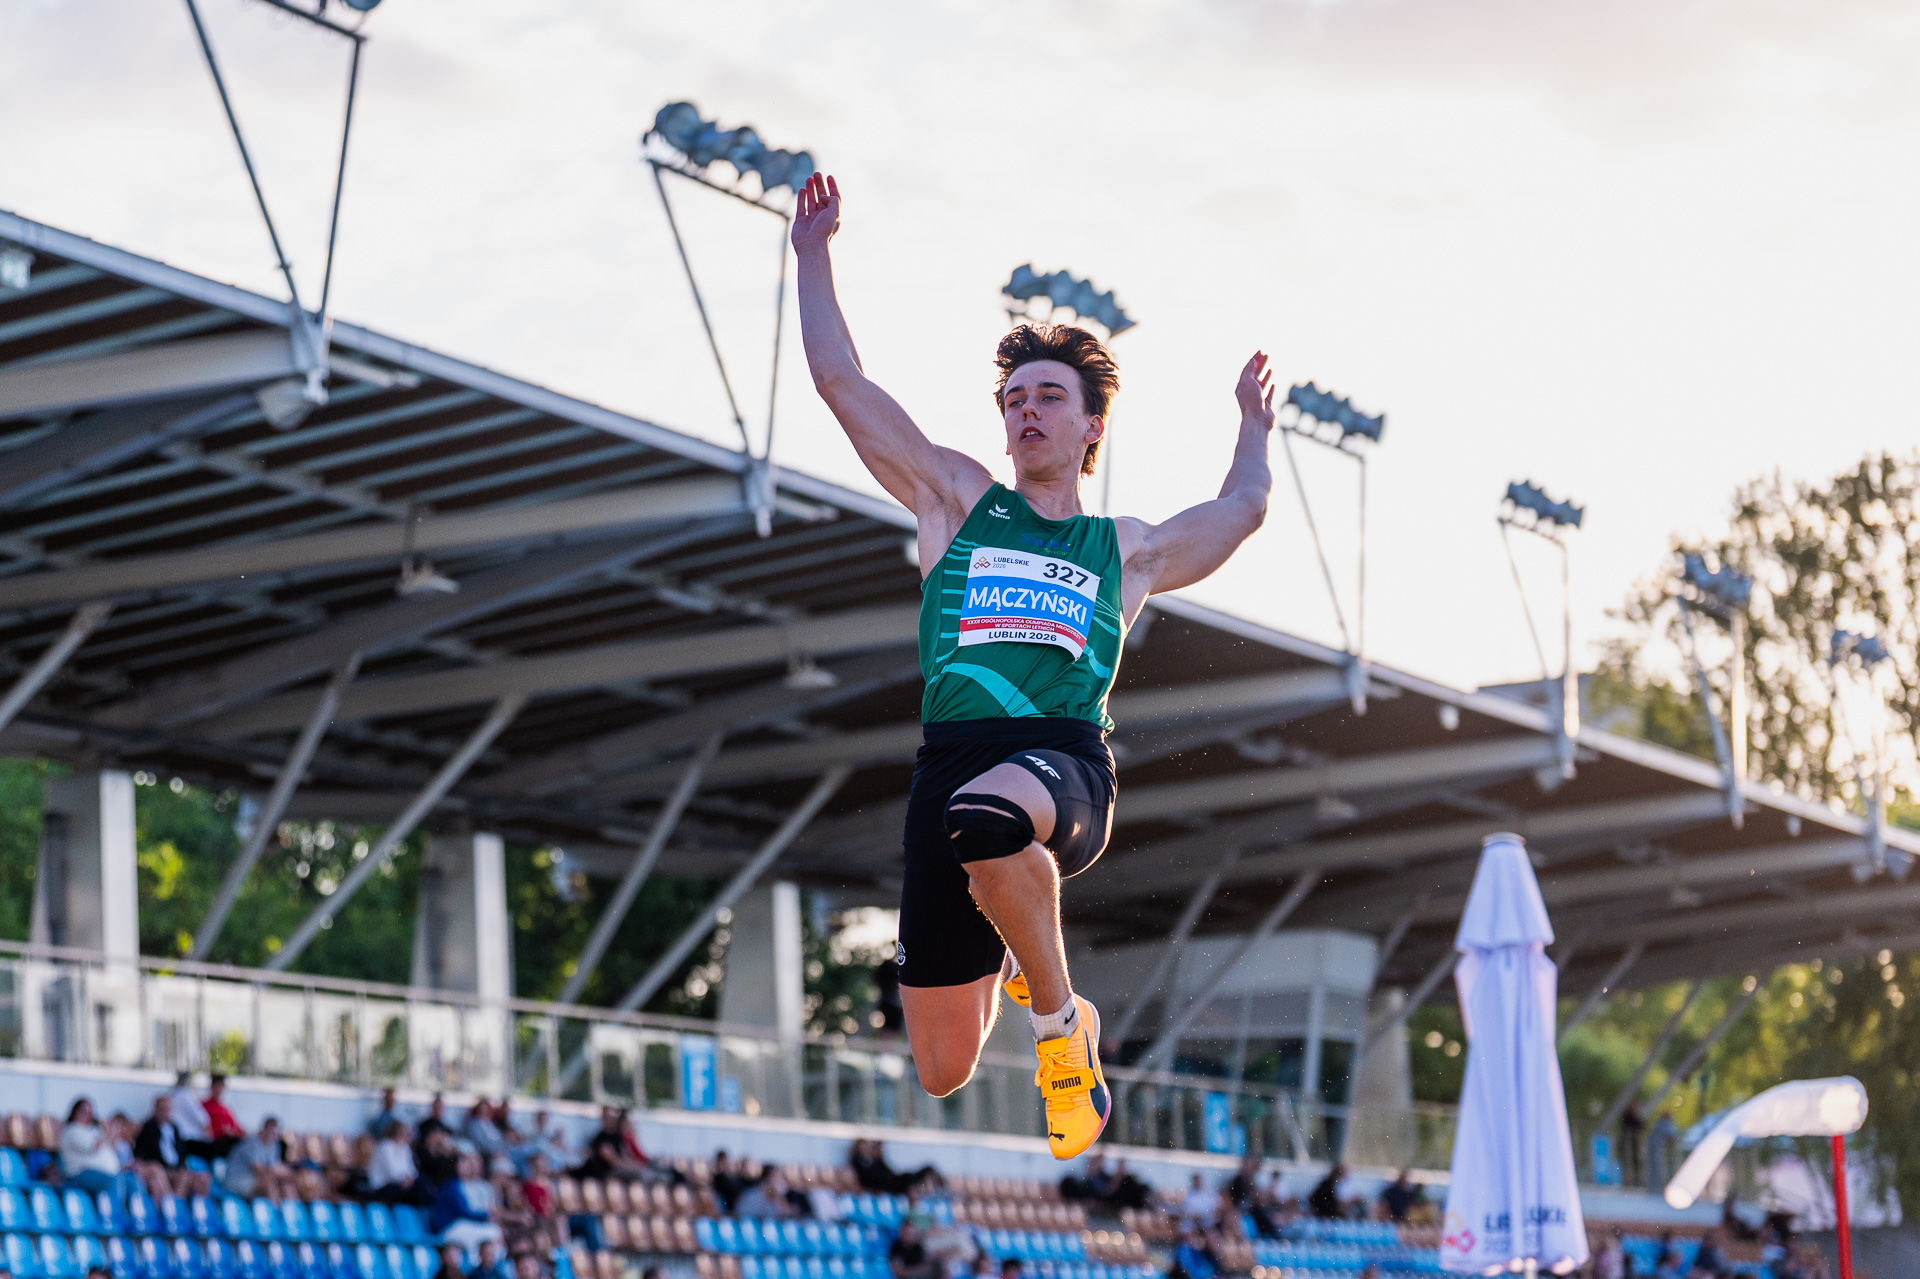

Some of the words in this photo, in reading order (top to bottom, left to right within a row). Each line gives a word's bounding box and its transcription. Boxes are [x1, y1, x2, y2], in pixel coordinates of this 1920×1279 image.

[988, 509, 1011, 520] erima
[993, 556, 1030, 567] LUBELSKIE
[1043, 562, 1089, 588] 327
[968, 586, 1088, 626] MĄCZYŃSKI
[1025, 619, 1056, 628] OLIMPIADA
[988, 631, 1027, 639] LUBLIN
[1028, 631, 1057, 642] 2026
[1051, 1075, 1082, 1091] PUMA
